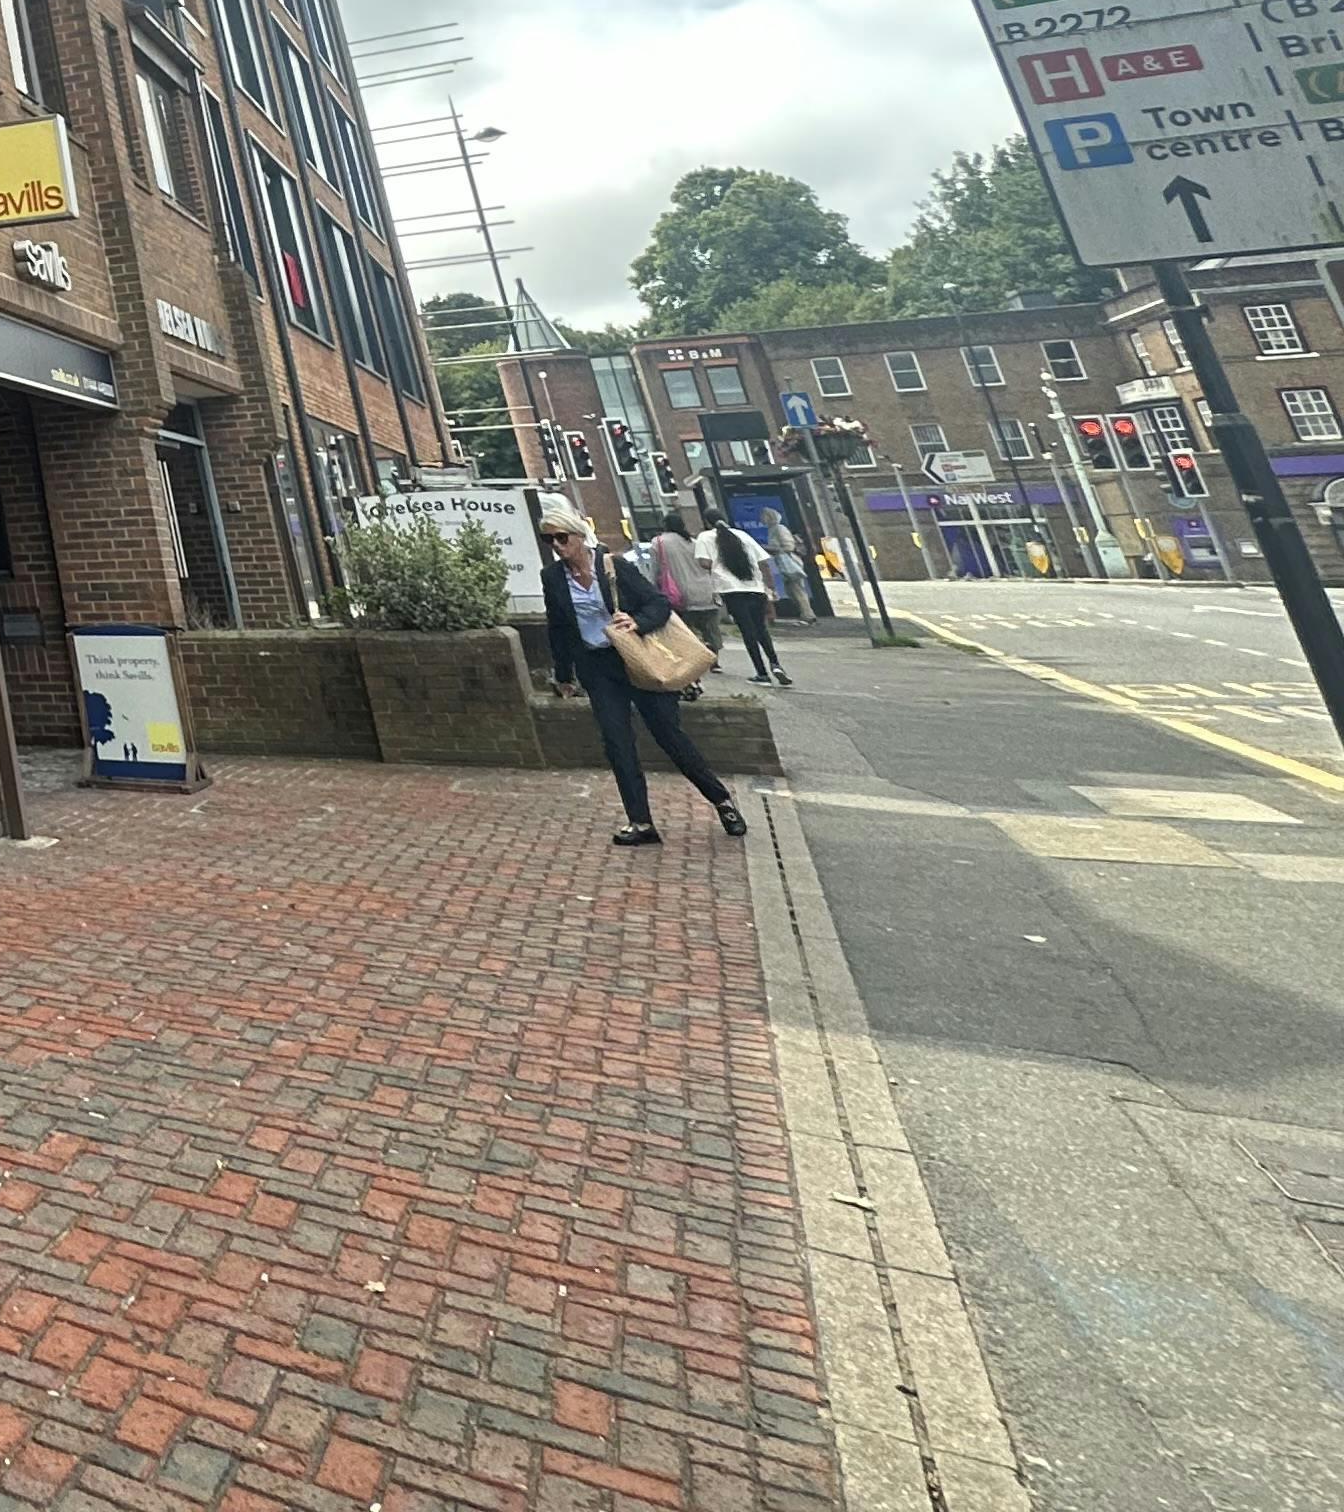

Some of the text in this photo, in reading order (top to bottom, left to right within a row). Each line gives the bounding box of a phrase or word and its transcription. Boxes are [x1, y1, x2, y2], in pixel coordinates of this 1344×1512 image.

[1277, 29, 1343, 58] Bri
[1033, 54, 1089, 97] H
[1142, 101, 1255, 130] Town
[1065, 122, 1111, 164] P
[1146, 130, 1282, 161] centre
[451, 498, 516, 515] House
[86, 654, 115, 665] Think
